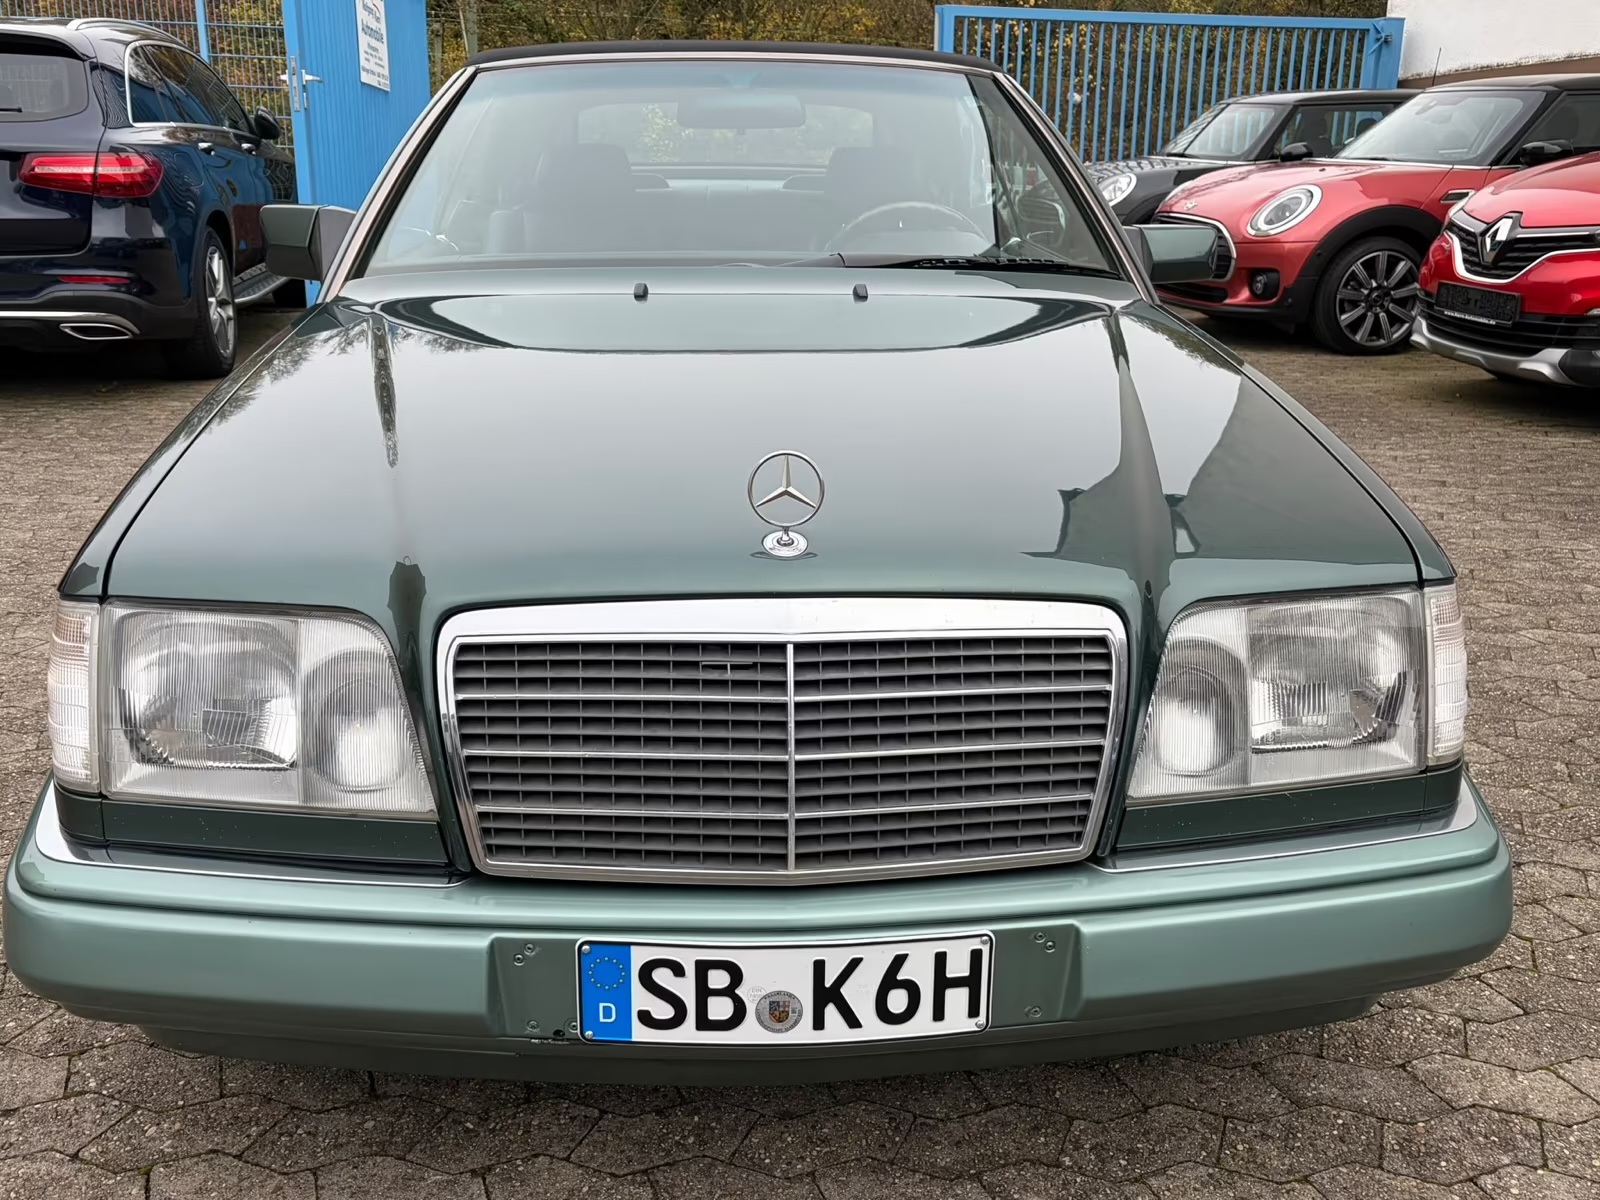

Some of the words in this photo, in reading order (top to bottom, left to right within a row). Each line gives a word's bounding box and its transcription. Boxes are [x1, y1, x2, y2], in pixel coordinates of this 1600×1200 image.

[599, 1002, 616, 1023] D
[637, 957, 747, 1031] SB
[812, 948, 983, 1031] K6H
